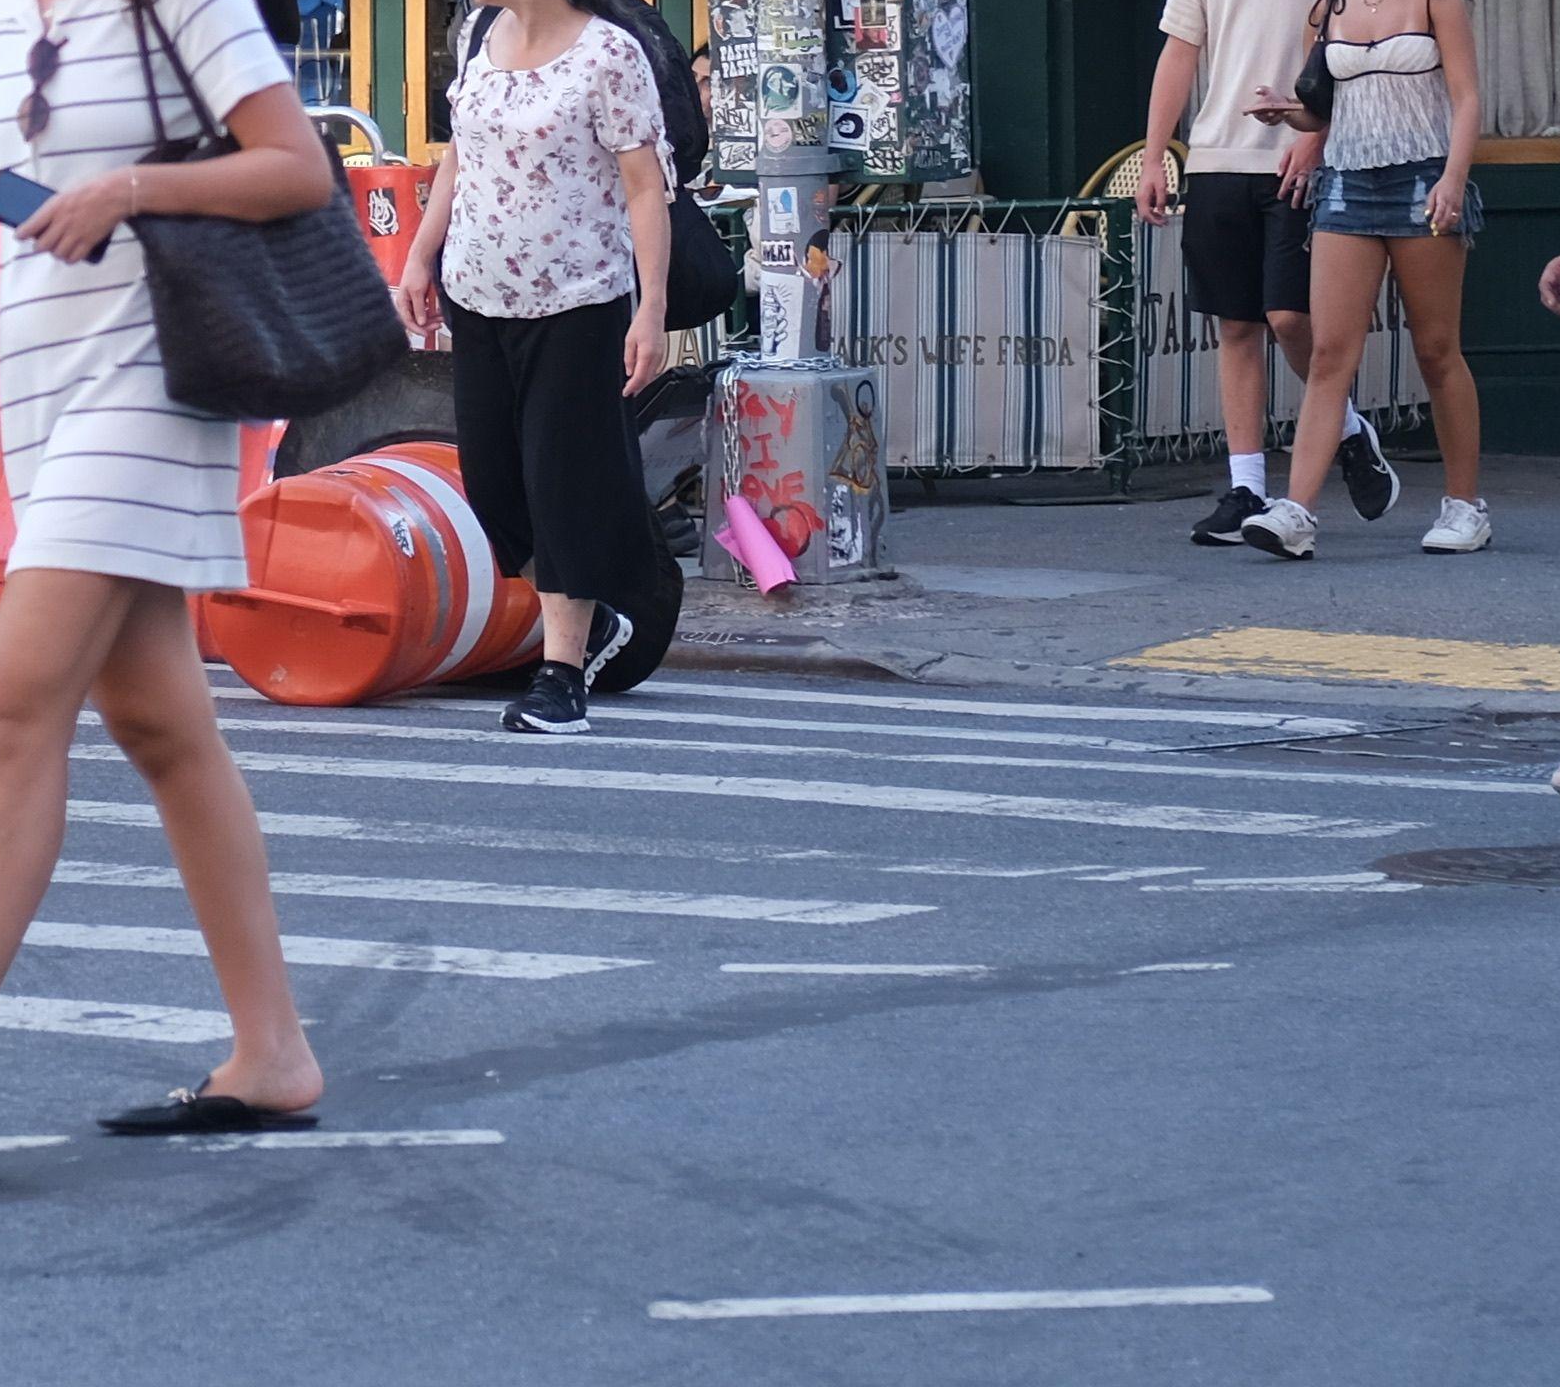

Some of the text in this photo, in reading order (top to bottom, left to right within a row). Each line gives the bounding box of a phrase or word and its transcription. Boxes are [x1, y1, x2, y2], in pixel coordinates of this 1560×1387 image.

[1141, 291, 1220, 357] JACK
[922, 336, 986, 367] WIFE
[996, 335, 1076, 367] FREDA
